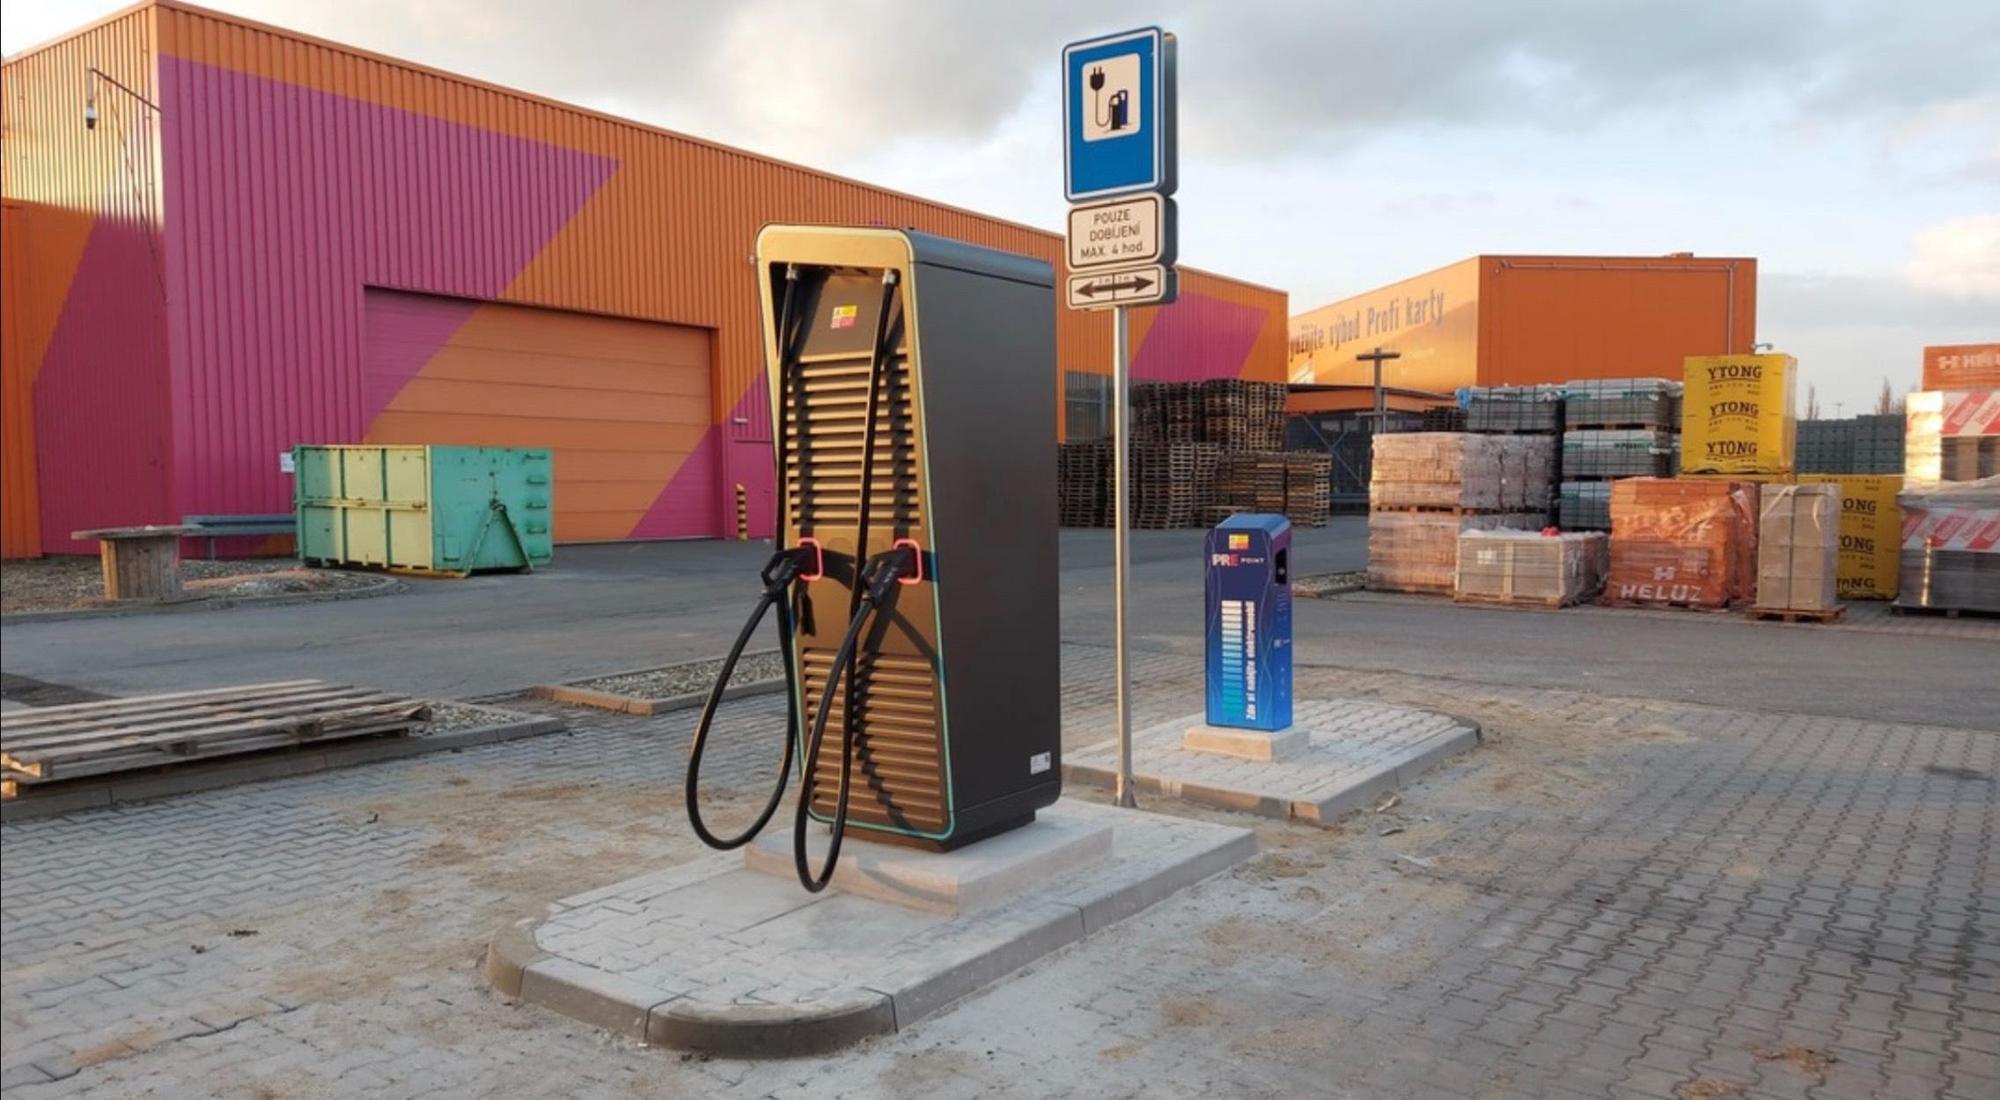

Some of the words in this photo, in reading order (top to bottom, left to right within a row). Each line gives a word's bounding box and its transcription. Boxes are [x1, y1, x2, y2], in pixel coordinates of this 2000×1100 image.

[1093, 208, 1131, 224] POUZE
[1366, 298, 1399, 337] Profi
[1405, 288, 1444, 326] karty
[1707, 365, 1763, 380] YTONG
[1709, 401, 1759, 417] YTONG
[1706, 440, 1758, 456] YTONG
[1842, 498, 1876, 513] ONG
[1839, 535, 1874, 552] ONG
[1212, 553, 1239, 567] PRE
[1620, 584, 1702, 602] HELUZ
